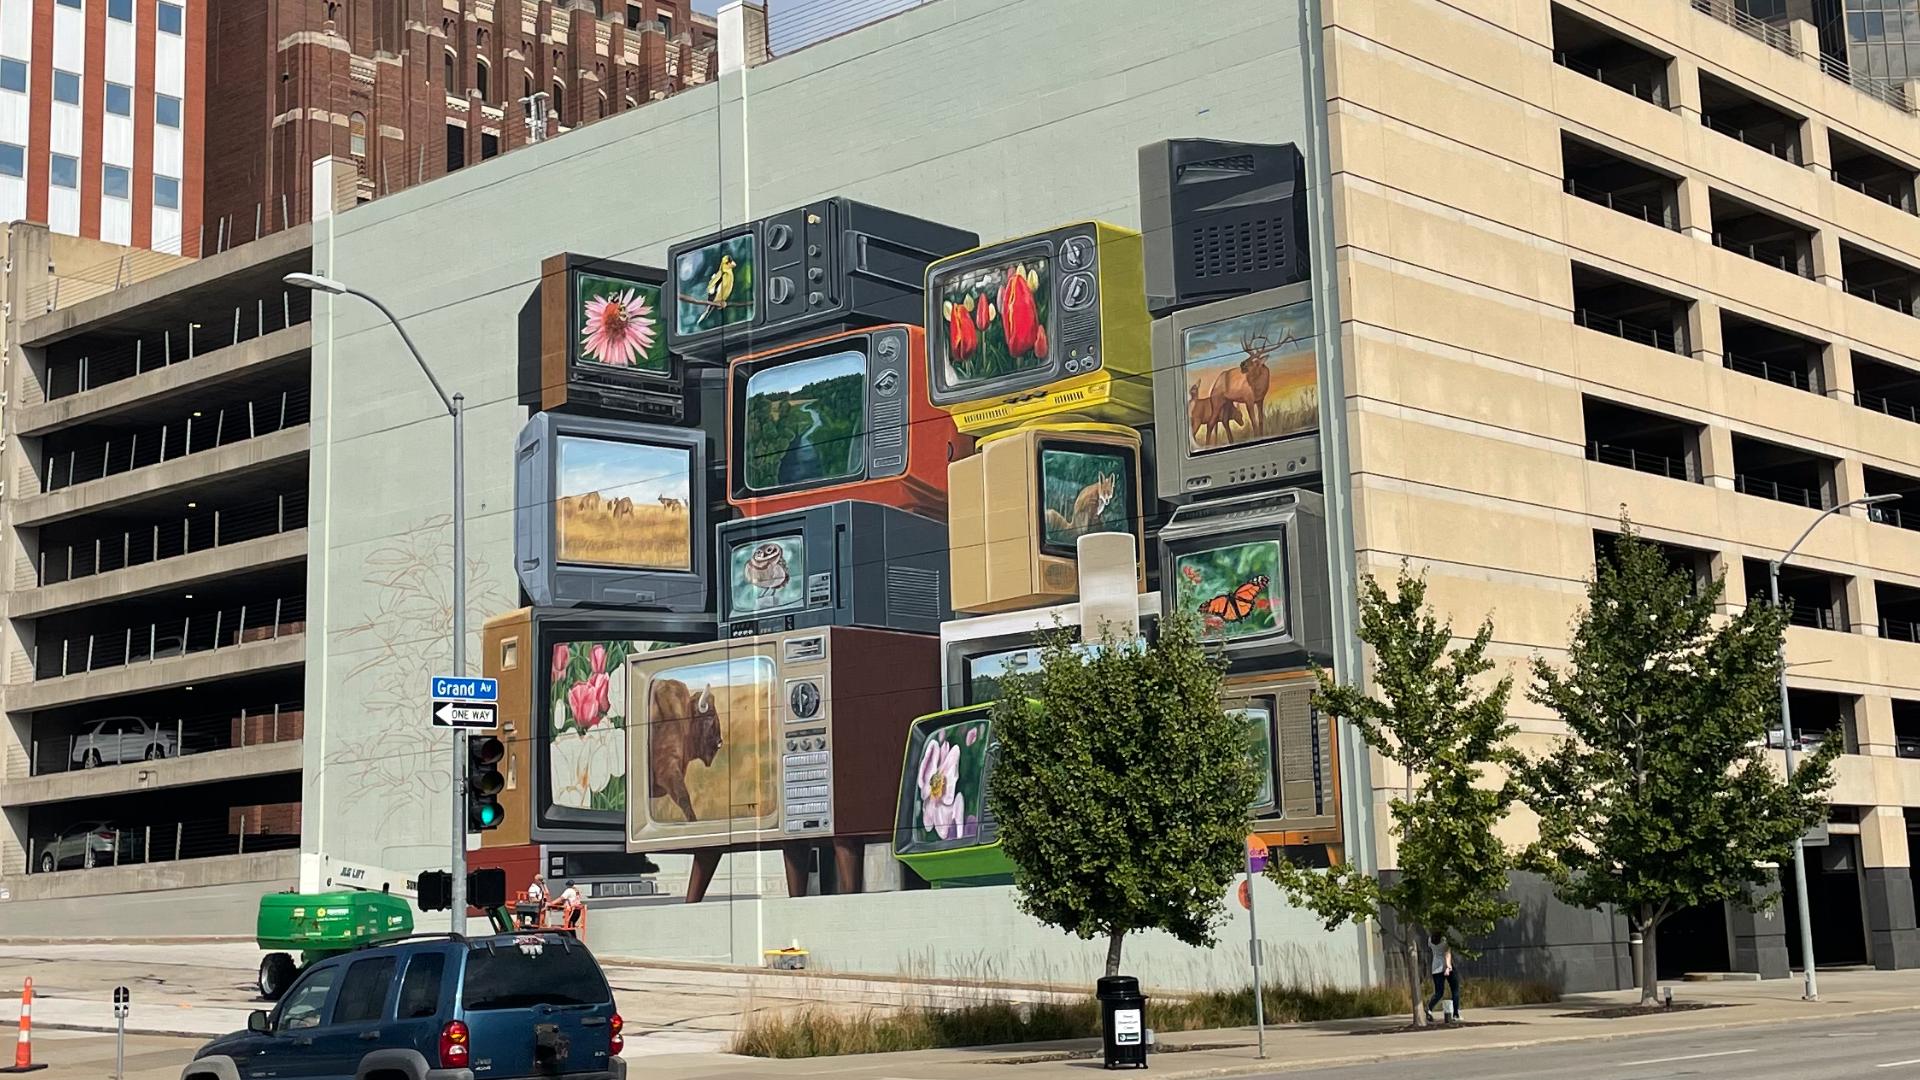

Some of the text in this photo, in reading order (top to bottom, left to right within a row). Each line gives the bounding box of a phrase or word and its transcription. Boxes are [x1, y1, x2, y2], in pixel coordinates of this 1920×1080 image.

[437, 680, 492, 696] Grand Av
[451, 709, 490, 721] ONE WAY
[352, 868, 365, 880] LIFT
